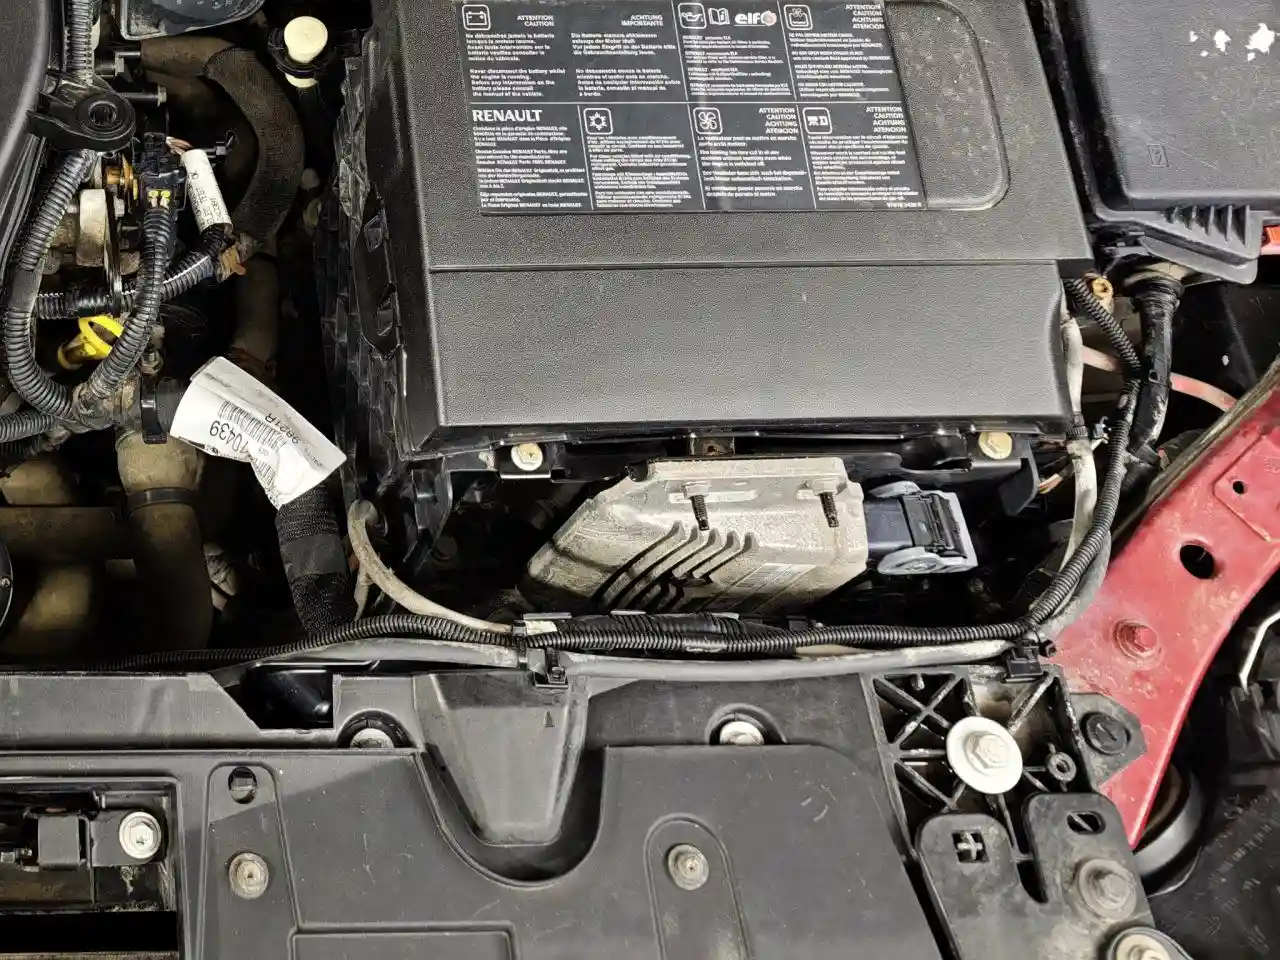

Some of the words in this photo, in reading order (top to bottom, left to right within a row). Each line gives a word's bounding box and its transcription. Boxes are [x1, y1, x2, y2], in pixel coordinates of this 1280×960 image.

[735, 12, 761, 25] elf
[472, 110, 542, 122] RENAULT
[264, 412, 300, 444] 9821R
